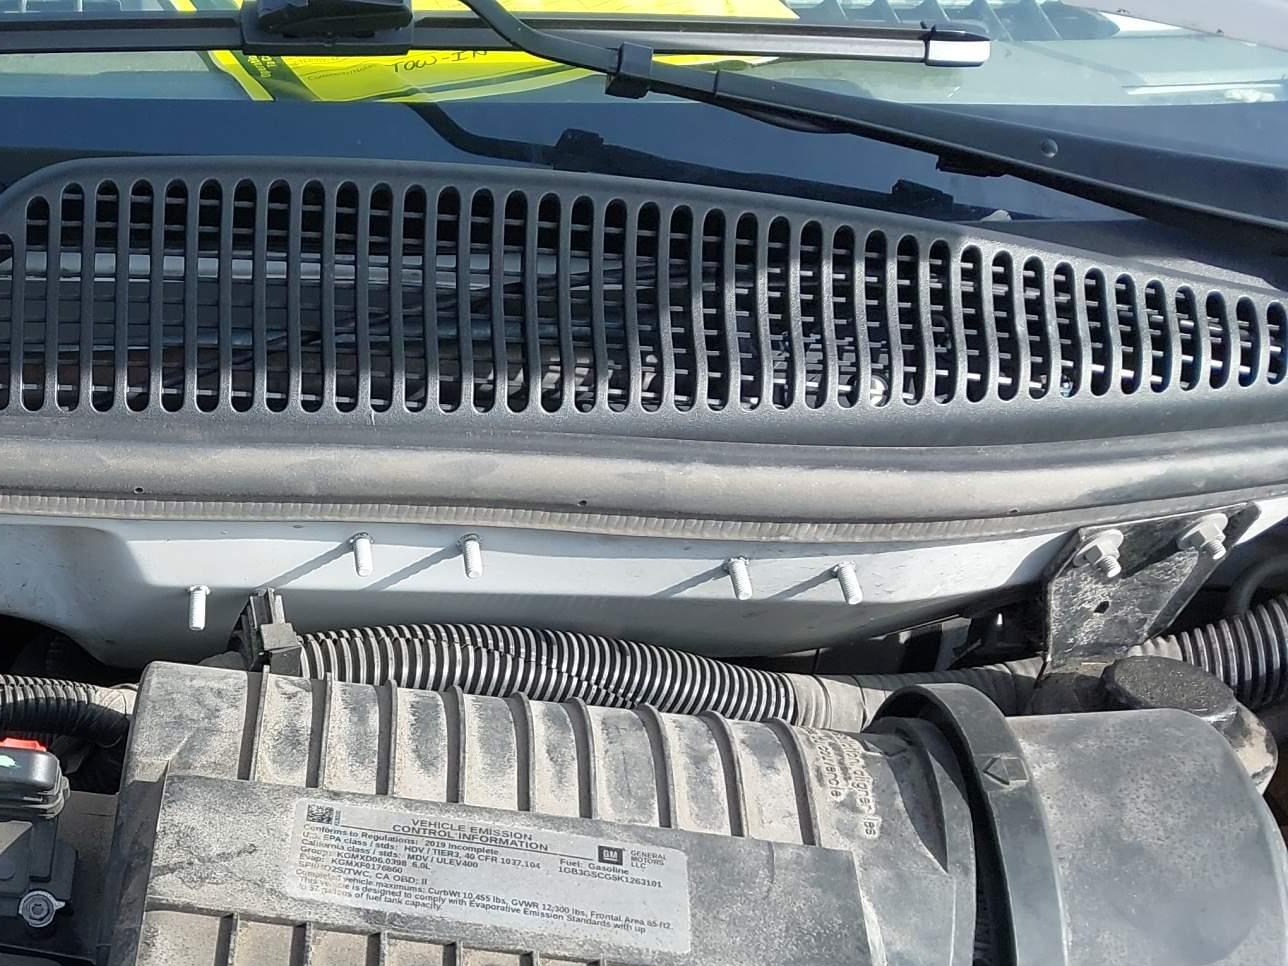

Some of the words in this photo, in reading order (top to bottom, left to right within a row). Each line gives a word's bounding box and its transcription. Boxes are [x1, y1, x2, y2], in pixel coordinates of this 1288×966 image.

[392, 824, 455, 839] CONTROL
[458, 831, 549, 851] INFORMATION
[412, 818, 466, 832] VEHICLE
[470, 826, 533, 841] EMISSION
[323, 833, 342, 843] EPA
[344, 837, 368, 847] class
[375, 841, 399, 851] stds:
[404, 845, 425, 854] HDV
[464, 852, 476, 861] 40
[477, 854, 498, 864] CFR
[349, 830, 359, 838] to
[424, 840, 446, 849] 2019
[448, 843, 500, 856] Incomplete
[347, 845, 370, 855] class
[407, 851, 429, 861] MDV
[436, 857, 479, 869] ULEV400
[559, 858, 583, 869] Fuel:
[588, 862, 630, 875] Gasoline
[630, 850, 666, 861] GENERAL
[631, 856, 665, 866] MOTORS
[631, 862, 647, 870] LLC
[375, 872, 390, 881] CA
[392, 874, 419, 884] OBD:
[361, 885, 402, 899] designed
[404, 890, 412, 899] to
[415, 893, 446, 905] comply
[448, 897, 468, 907] with
[469, 900, 521, 915] Evaporative
[523, 907, 564, 921] Emission
[566, 914, 612, 929] Standards
[634, 926, 646, 936] up
[428, 887, 461, 898] CurbWt
[511, 898, 539, 909] GVWR
[625, 916, 645, 926] Area
